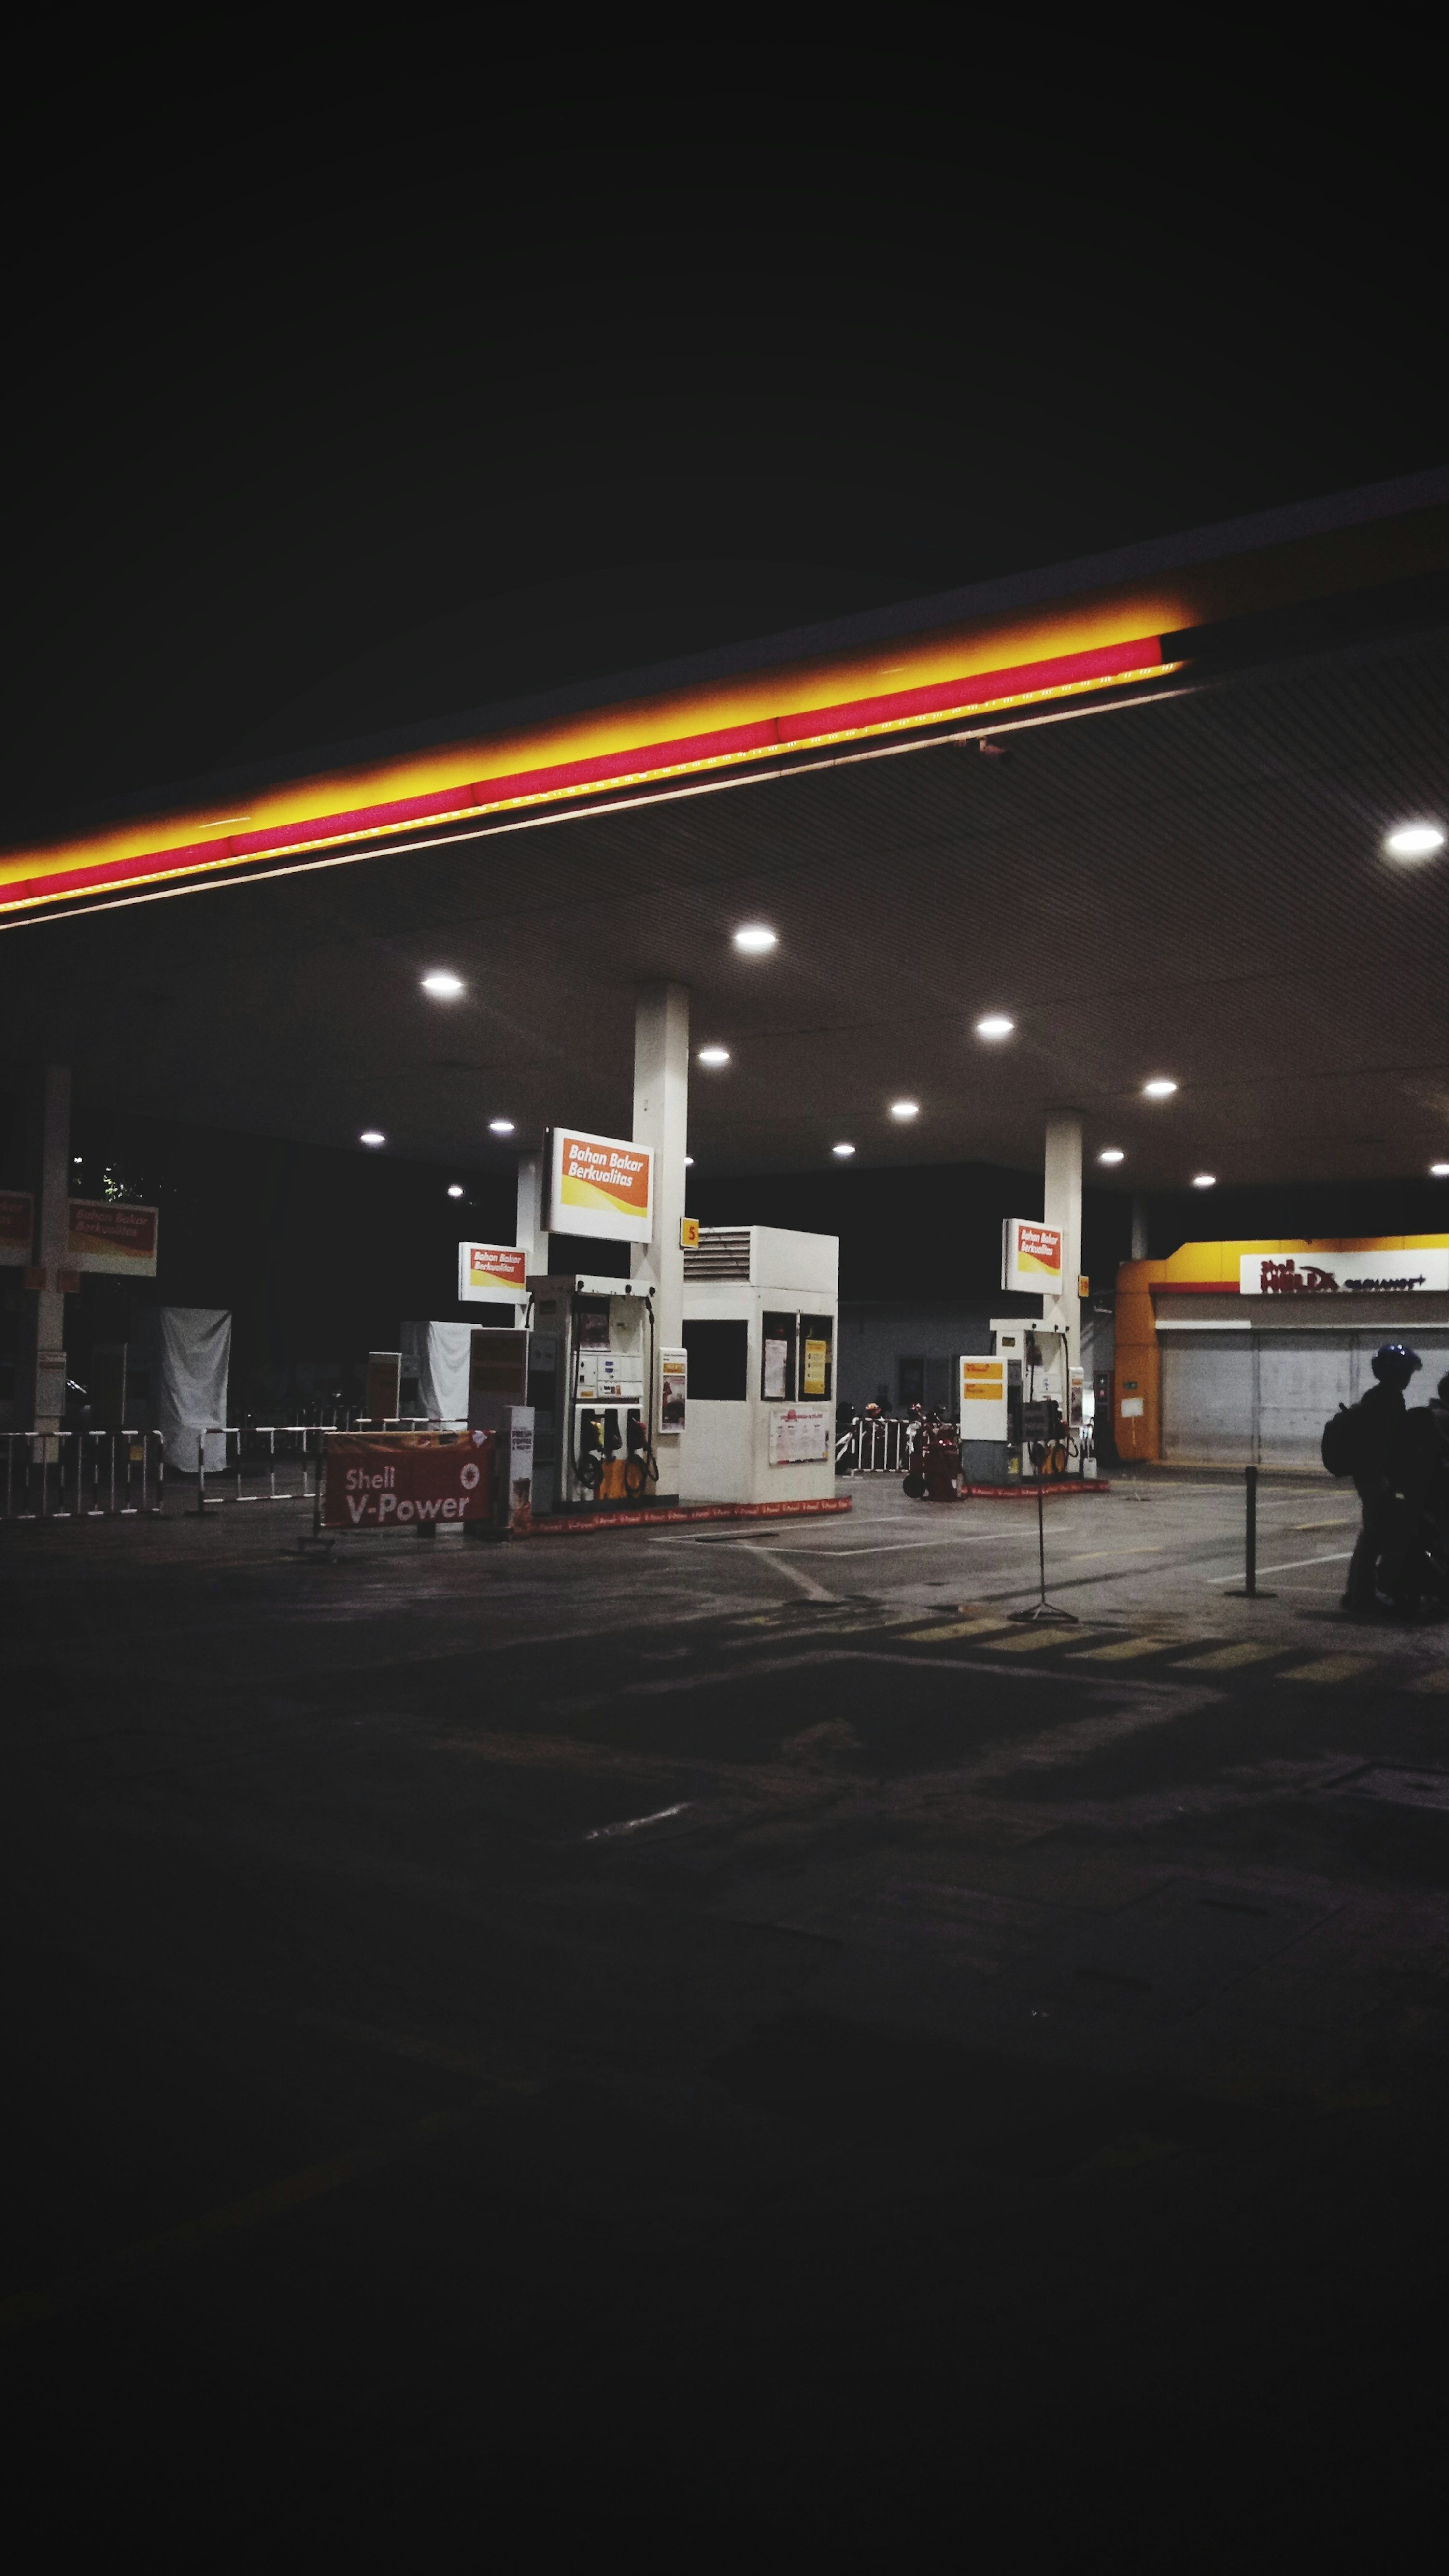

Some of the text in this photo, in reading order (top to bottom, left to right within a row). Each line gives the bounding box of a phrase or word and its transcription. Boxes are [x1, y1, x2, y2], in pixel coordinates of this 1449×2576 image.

[569, 1144, 643, 1172] Bahan Bakar
[568, 1161, 633, 1187] Berkualitas
[688, 1226, 695, 1240] 5
[474, 1251, 522, 1264] Bahan Bakar
[474, 1260, 515, 1273] Berkualitas
[345, 1466, 395, 1490] Shell
[345, 1493, 470, 1523] V-Power
